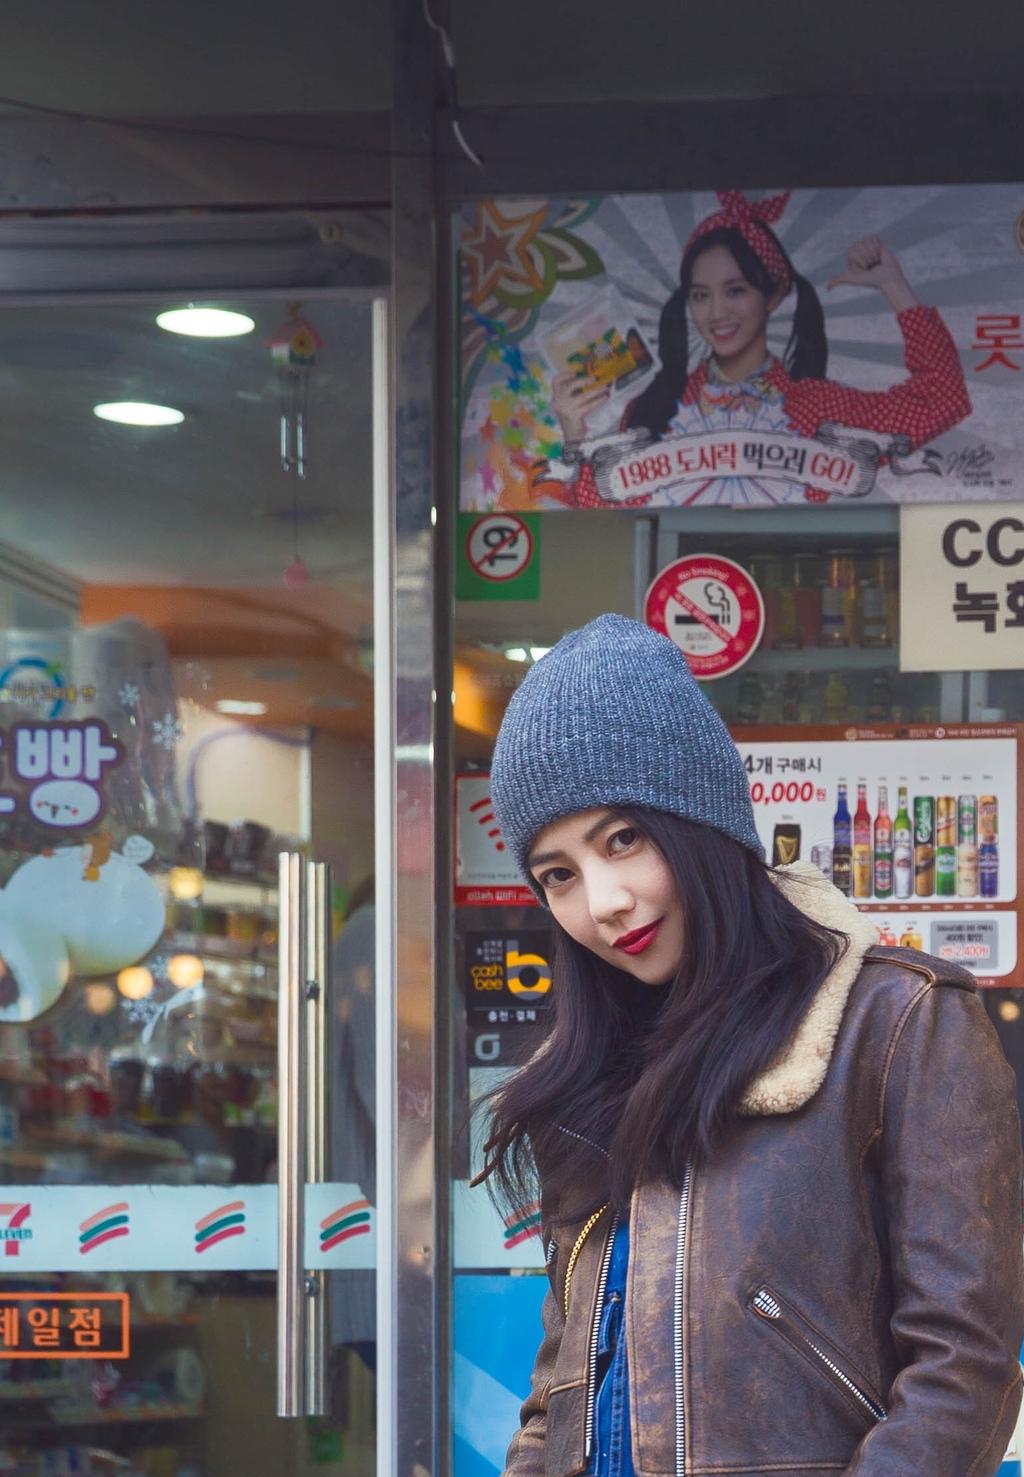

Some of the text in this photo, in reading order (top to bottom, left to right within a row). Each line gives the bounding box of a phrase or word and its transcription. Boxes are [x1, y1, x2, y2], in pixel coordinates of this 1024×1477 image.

[618, 450, 673, 488] 1988
[676, 442, 738, 472] 도시락
[811, 450, 855, 485] GO!
